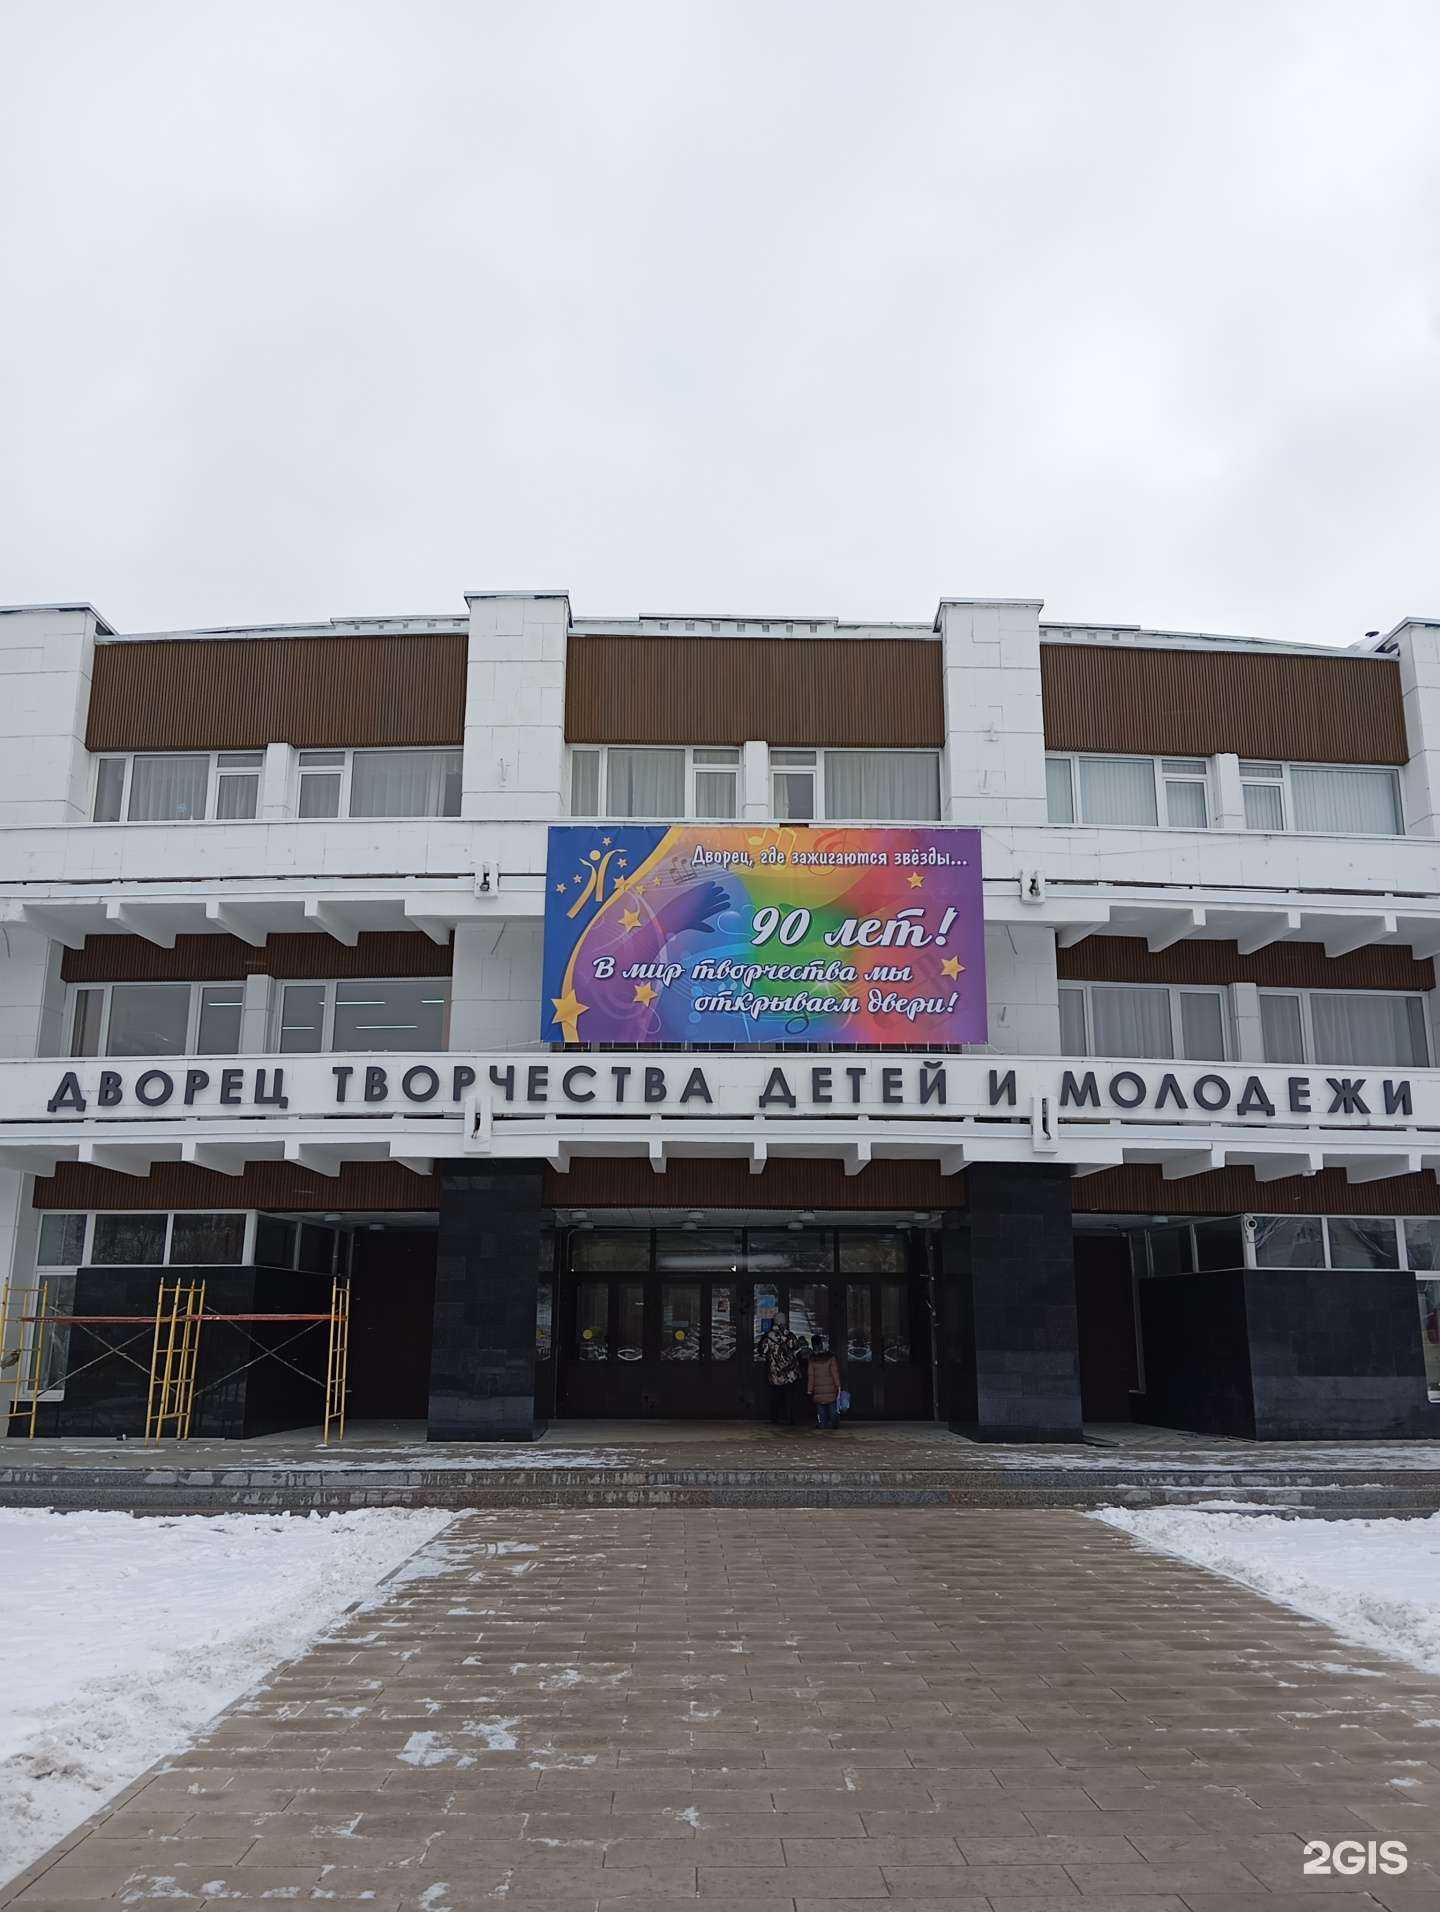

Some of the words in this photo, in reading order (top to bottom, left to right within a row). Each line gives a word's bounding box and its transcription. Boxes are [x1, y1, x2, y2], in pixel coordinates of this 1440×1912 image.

[691, 845, 753, 869] Дворец,
[760, 846, 785, 865] где
[791, 850, 887, 866] зажигаются
[894, 846, 968, 866] звёзды...
[751, 906, 812, 946] 90
[824, 905, 959, 947] лет!
[592, 956, 616, 979] В
[622, 965, 684, 988] мир
[691, 958, 858, 988] творчества
[863, 966, 913, 982] мы
[694, 991, 860, 1021] открываем
[867, 988, 960, 1021] двери!
[47, 1067, 289, 1112] ДВОРЕЦ
[332, 1064, 714, 1104] ТВОРЧЕСТВА
[758, 1061, 947, 1108] ДЕТЕЙ
[989, 1069, 1017, 1106] И
[1060, 1070, 1413, 1116] МОЛОДЕЖИ
